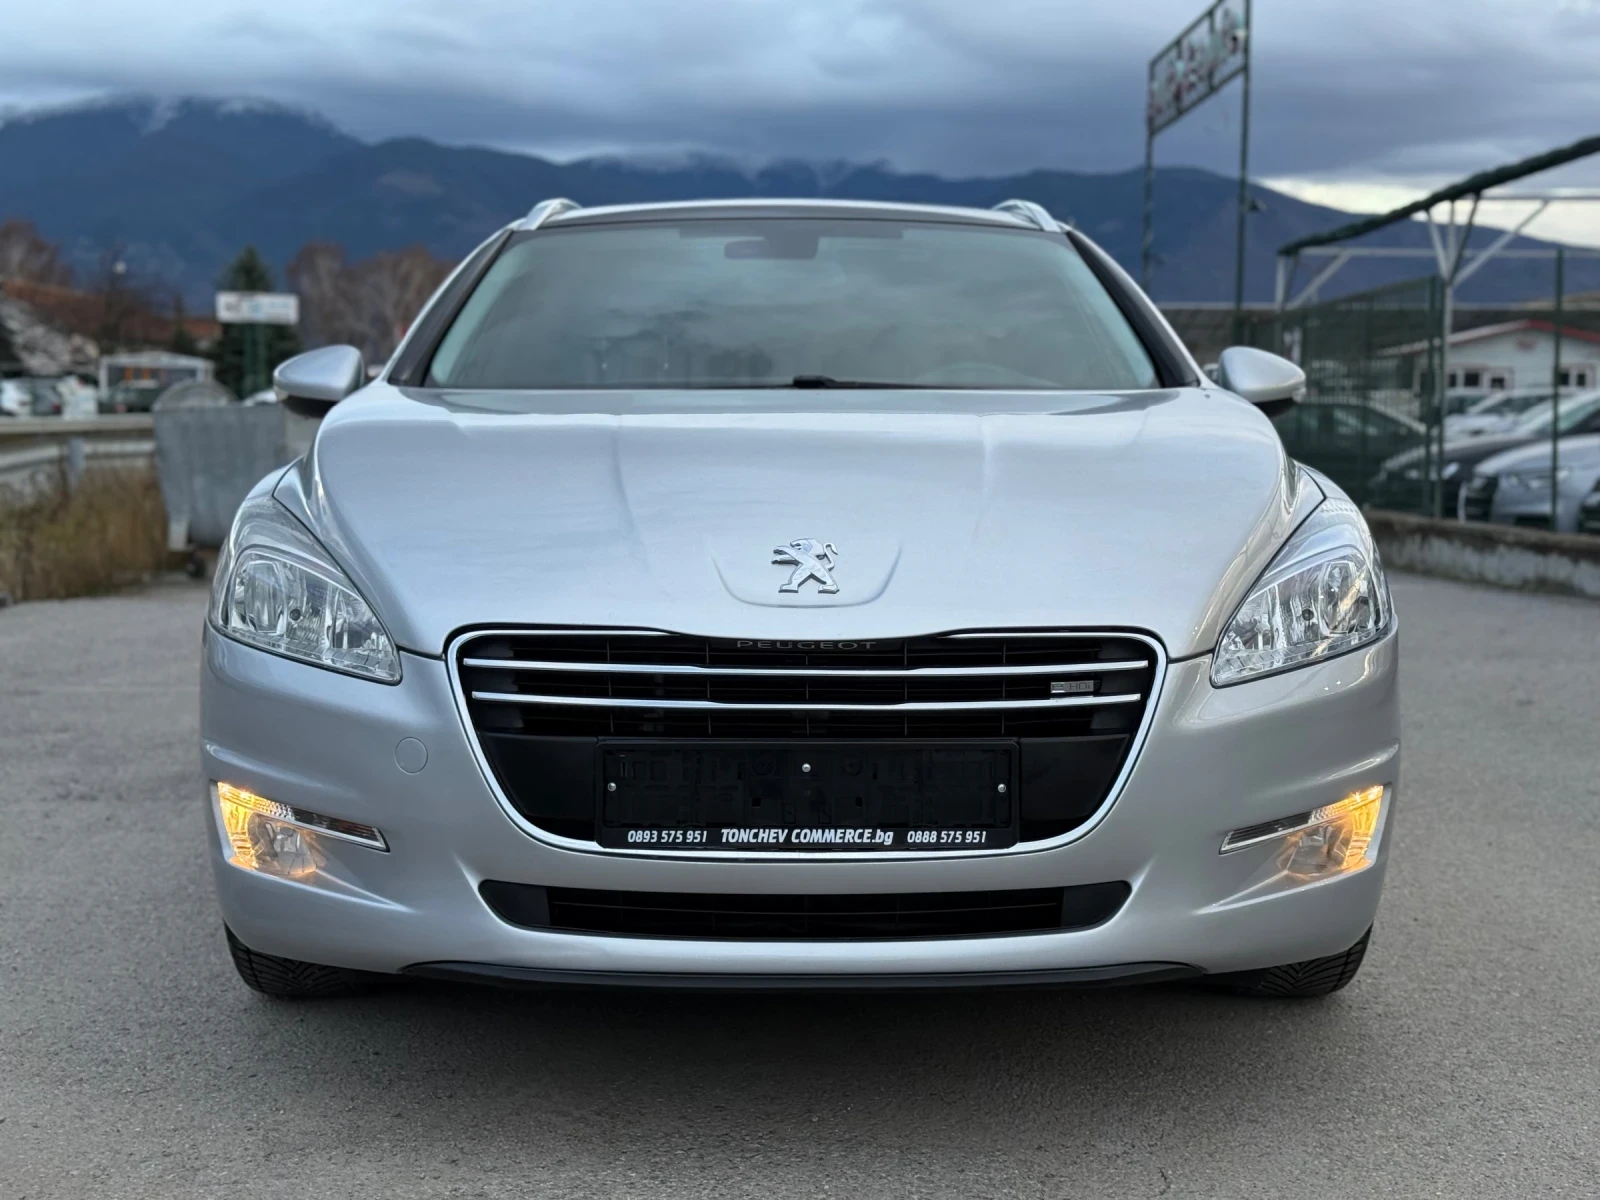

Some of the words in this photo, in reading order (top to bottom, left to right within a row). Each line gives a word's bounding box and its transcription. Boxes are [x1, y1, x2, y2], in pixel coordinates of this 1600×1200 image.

[737, 640, 876, 650] PEUGEOT
[627, 830, 658, 843] 0893
[660, 830, 684, 843] 575
[686, 830, 708, 843] 951
[720, 828, 789, 843] TONCHEV
[791, 828, 894, 846] COMMERCE.bg
[906, 830, 938, 843] 0888
[939, 830, 963, 843] 575
[964, 830, 987, 843] 951
